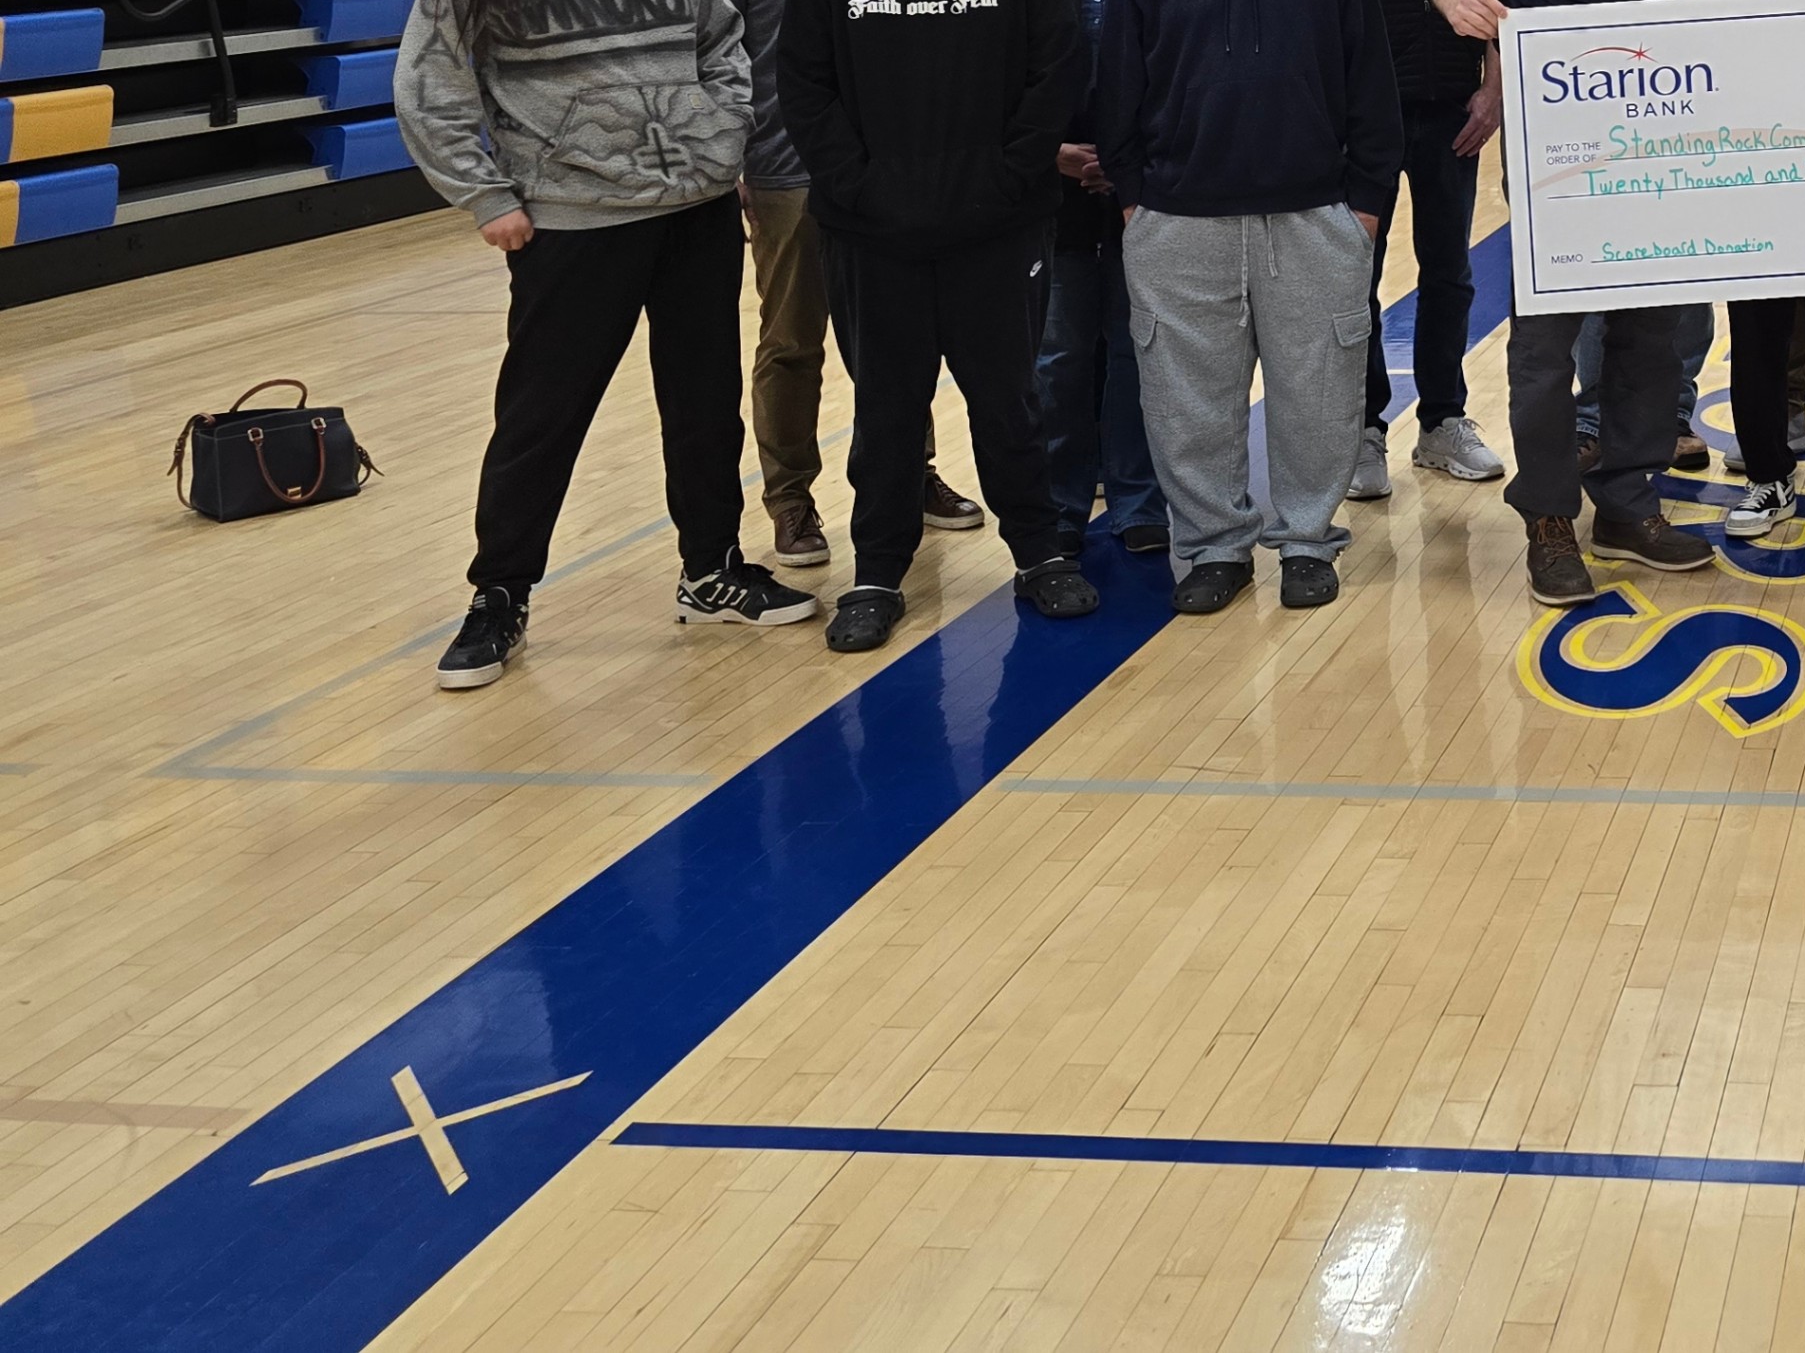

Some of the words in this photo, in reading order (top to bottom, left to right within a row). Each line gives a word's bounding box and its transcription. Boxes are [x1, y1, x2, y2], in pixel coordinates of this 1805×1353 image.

[906, 0, 948, 15] over
[1626, 99, 1695, 118] BANK
[1546, 144, 1565, 154] PAY
[1567, 143, 1578, 153] TO
[1580, 141, 1600, 151] THE
[1609, 124, 1716, 166] Standing
[1719, 126, 1766, 151] Rock
[1546, 154, 1581, 165] ORDER
[1583, 153, 1597, 163] OF
[1581, 168, 1664, 199] Twenty
[1765, 166, 1802, 183] and
[1704, 237, 1773, 256] Donation
[1551, 253, 1583, 264] MEMO
